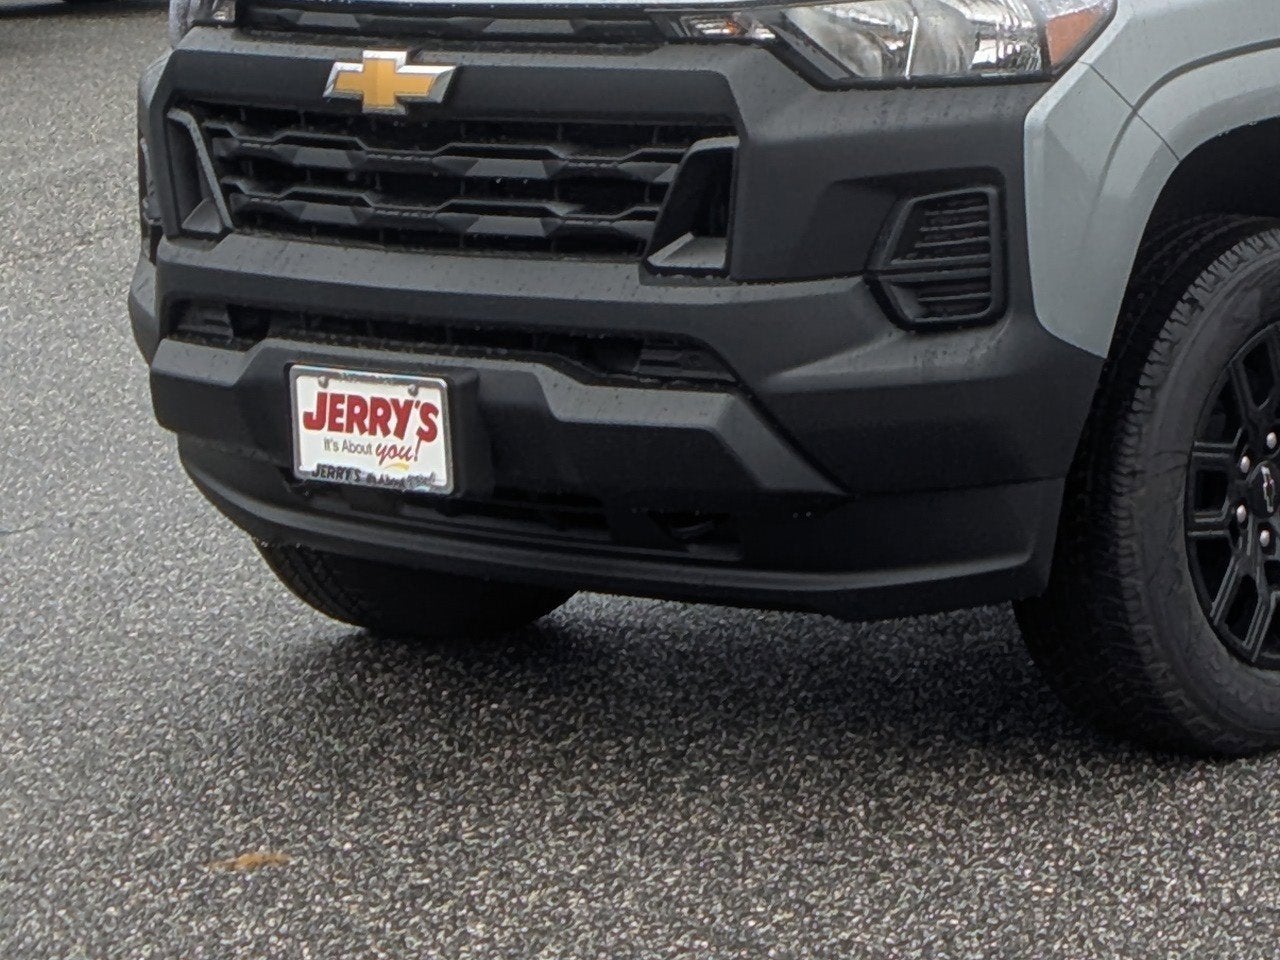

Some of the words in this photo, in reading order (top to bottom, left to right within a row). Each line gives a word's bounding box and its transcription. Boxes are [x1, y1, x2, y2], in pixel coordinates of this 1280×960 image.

[302, 391, 440, 444] JERRY'S
[323, 436, 340, 452] It's
[342, 439, 373, 456] About
[374, 439, 421, 466] you!
